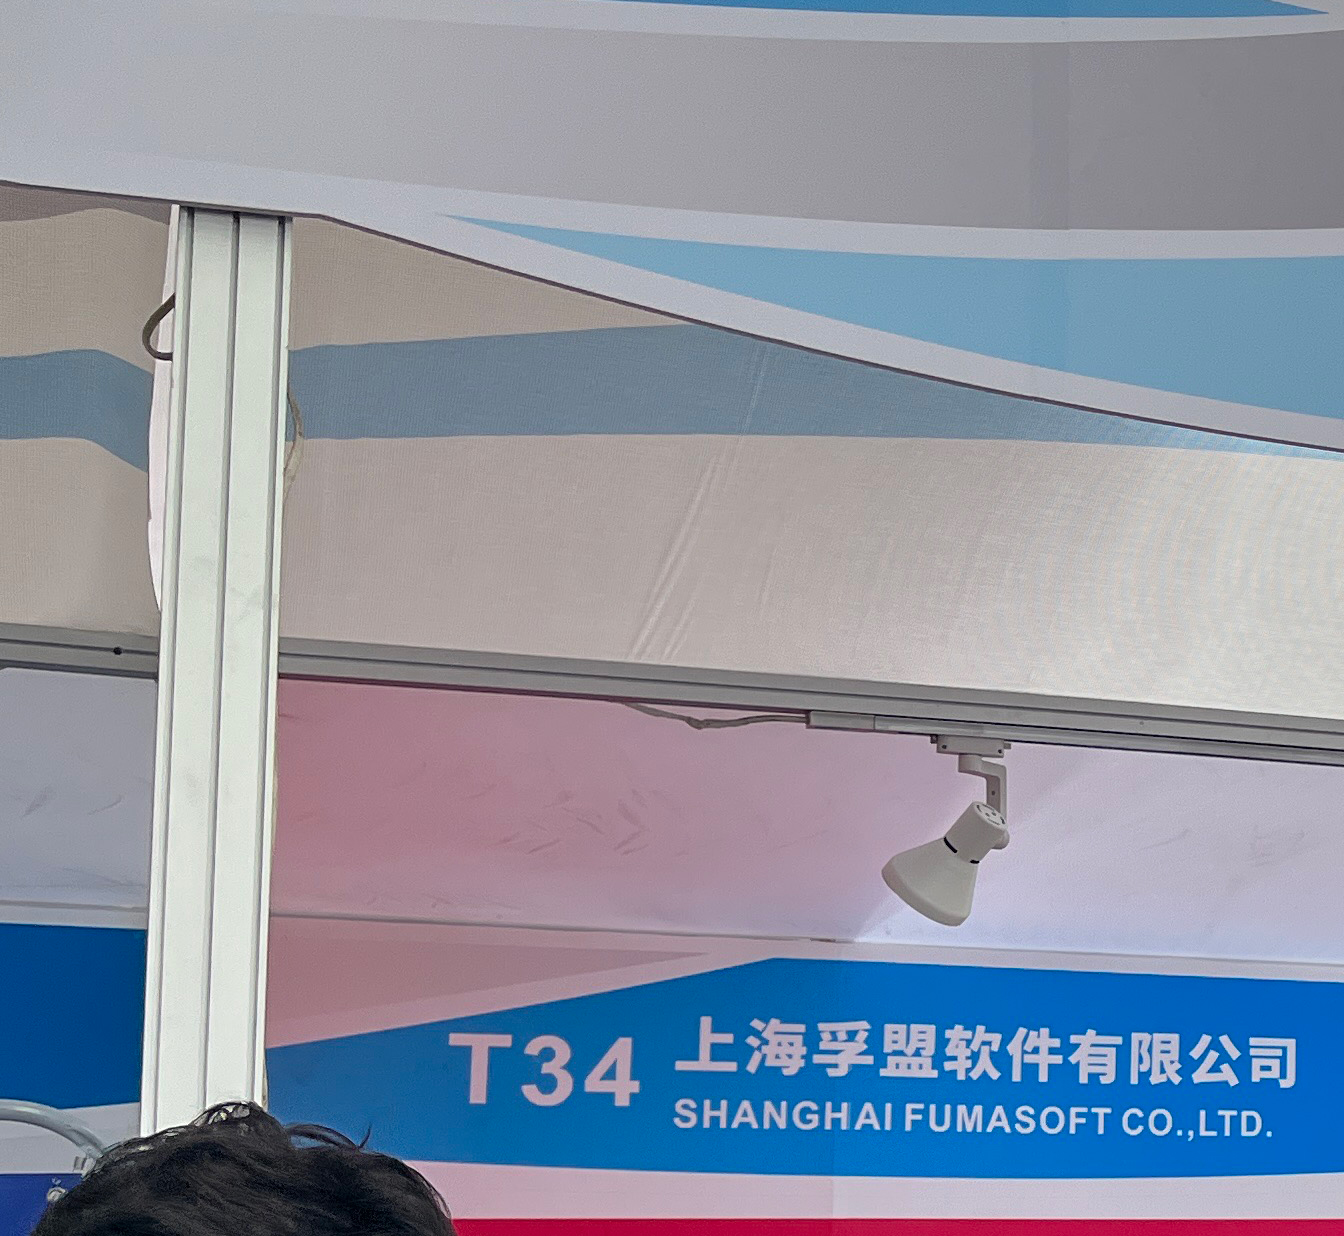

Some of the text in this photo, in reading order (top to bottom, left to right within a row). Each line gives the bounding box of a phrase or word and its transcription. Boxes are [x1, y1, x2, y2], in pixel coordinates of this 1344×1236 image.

[448, 1015, 1297, 1108] T34 上海孚盟软件有限公司
[673, 1098, 1274, 1140] SHANGHAI FUMASOFT CO.,LTD.
